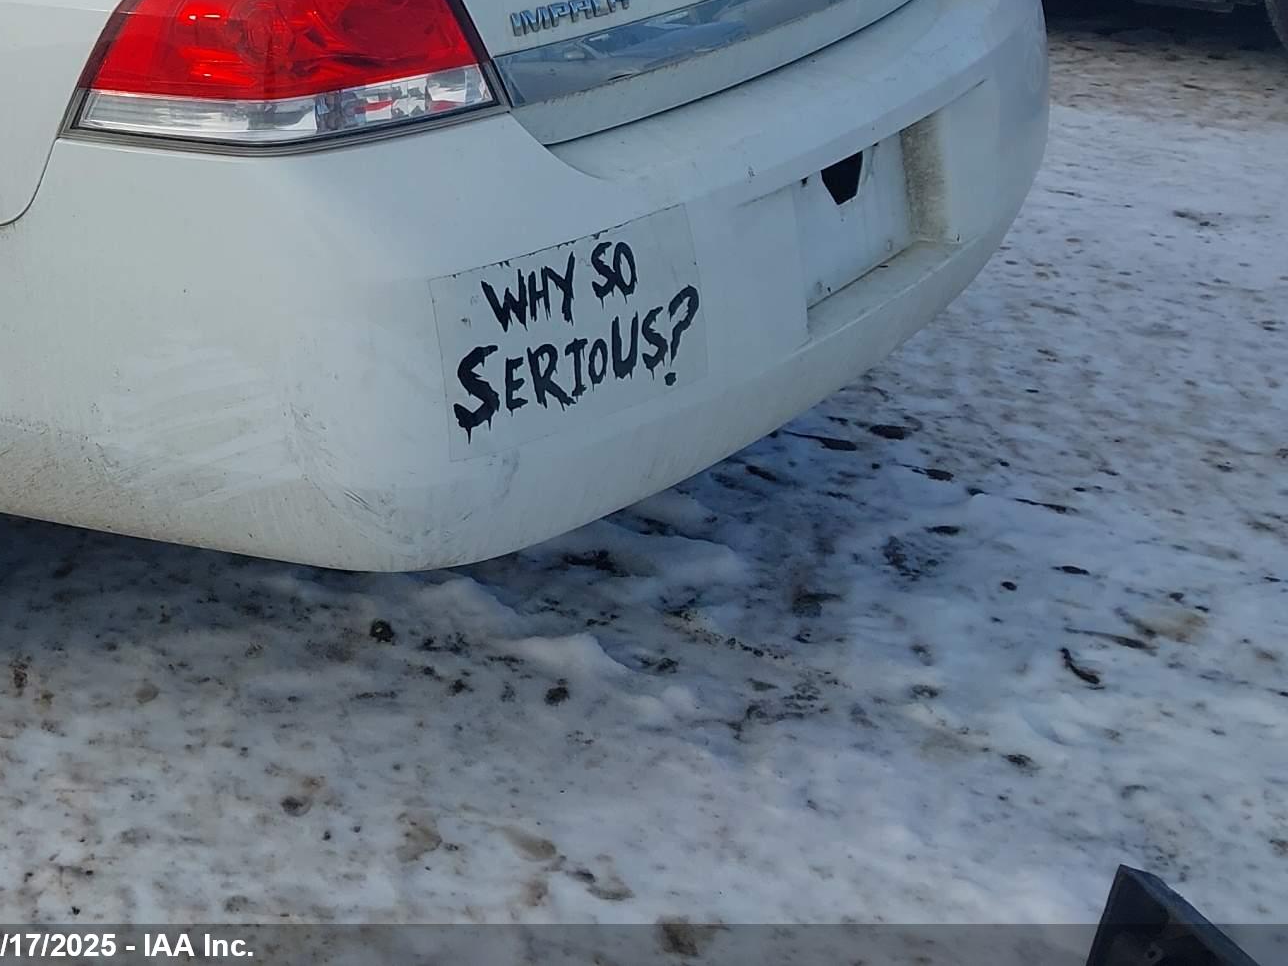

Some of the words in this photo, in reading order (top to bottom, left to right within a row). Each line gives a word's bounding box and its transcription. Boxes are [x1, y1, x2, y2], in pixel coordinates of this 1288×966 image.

[480, 251, 575, 333] WHY
[590, 242, 638, 310] SO
[453, 285, 699, 444] SERIOUS?
